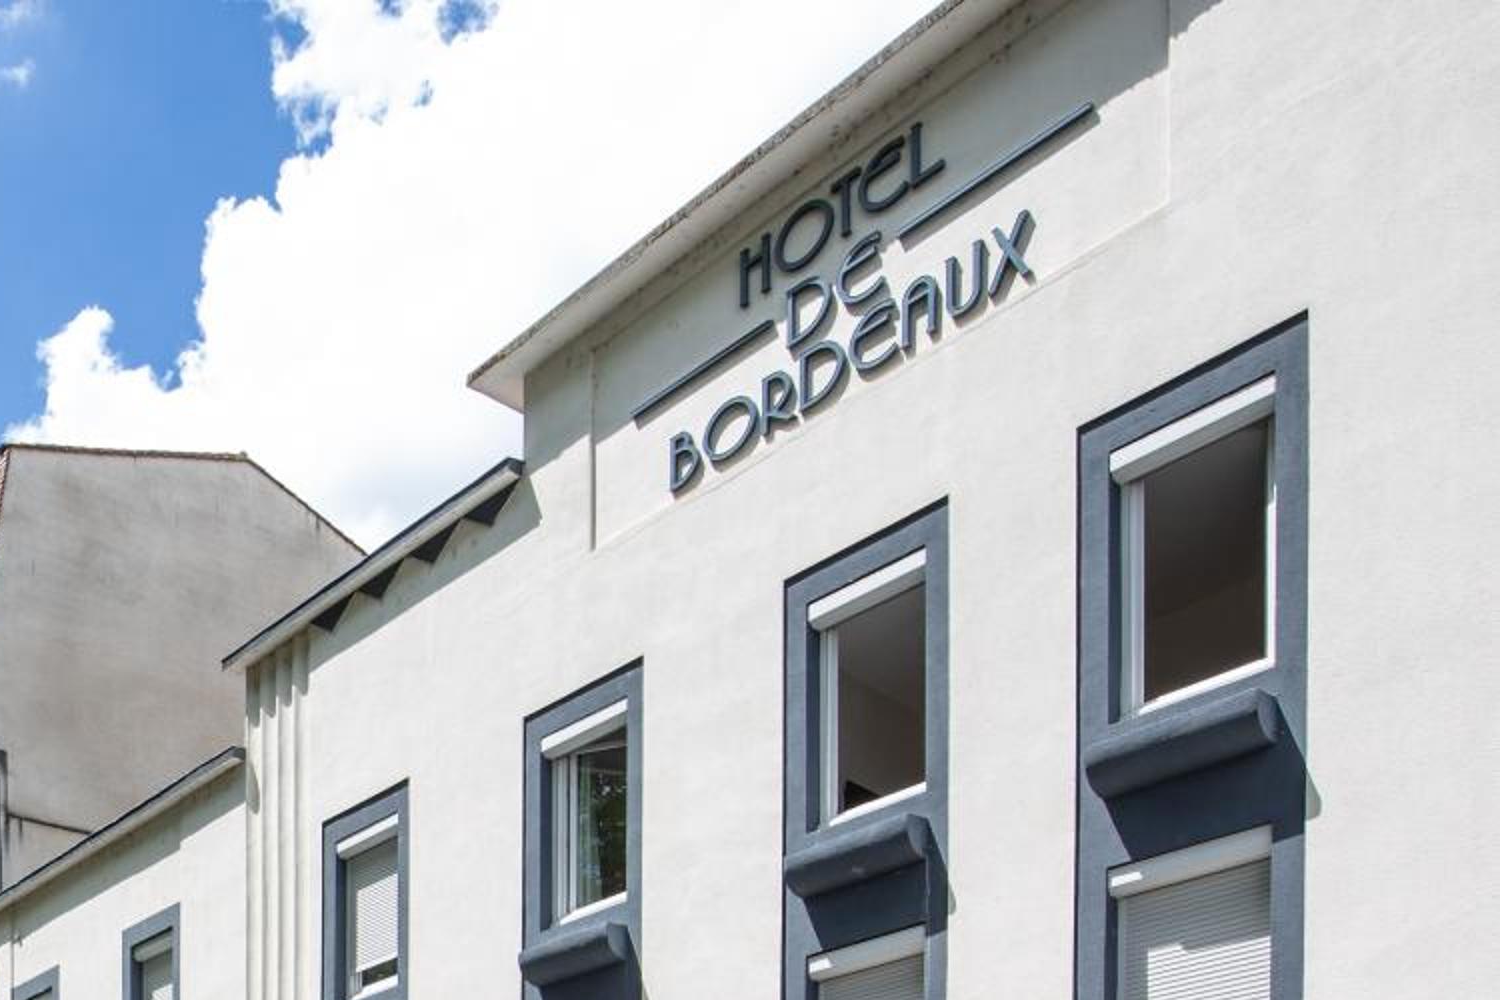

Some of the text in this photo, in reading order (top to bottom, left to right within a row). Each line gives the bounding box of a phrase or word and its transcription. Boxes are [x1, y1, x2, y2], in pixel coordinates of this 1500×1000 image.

[738, 121, 946, 308] HOTEL
[785, 230, 883, 350] DE
[669, 209, 1036, 493] BORDEAUX
